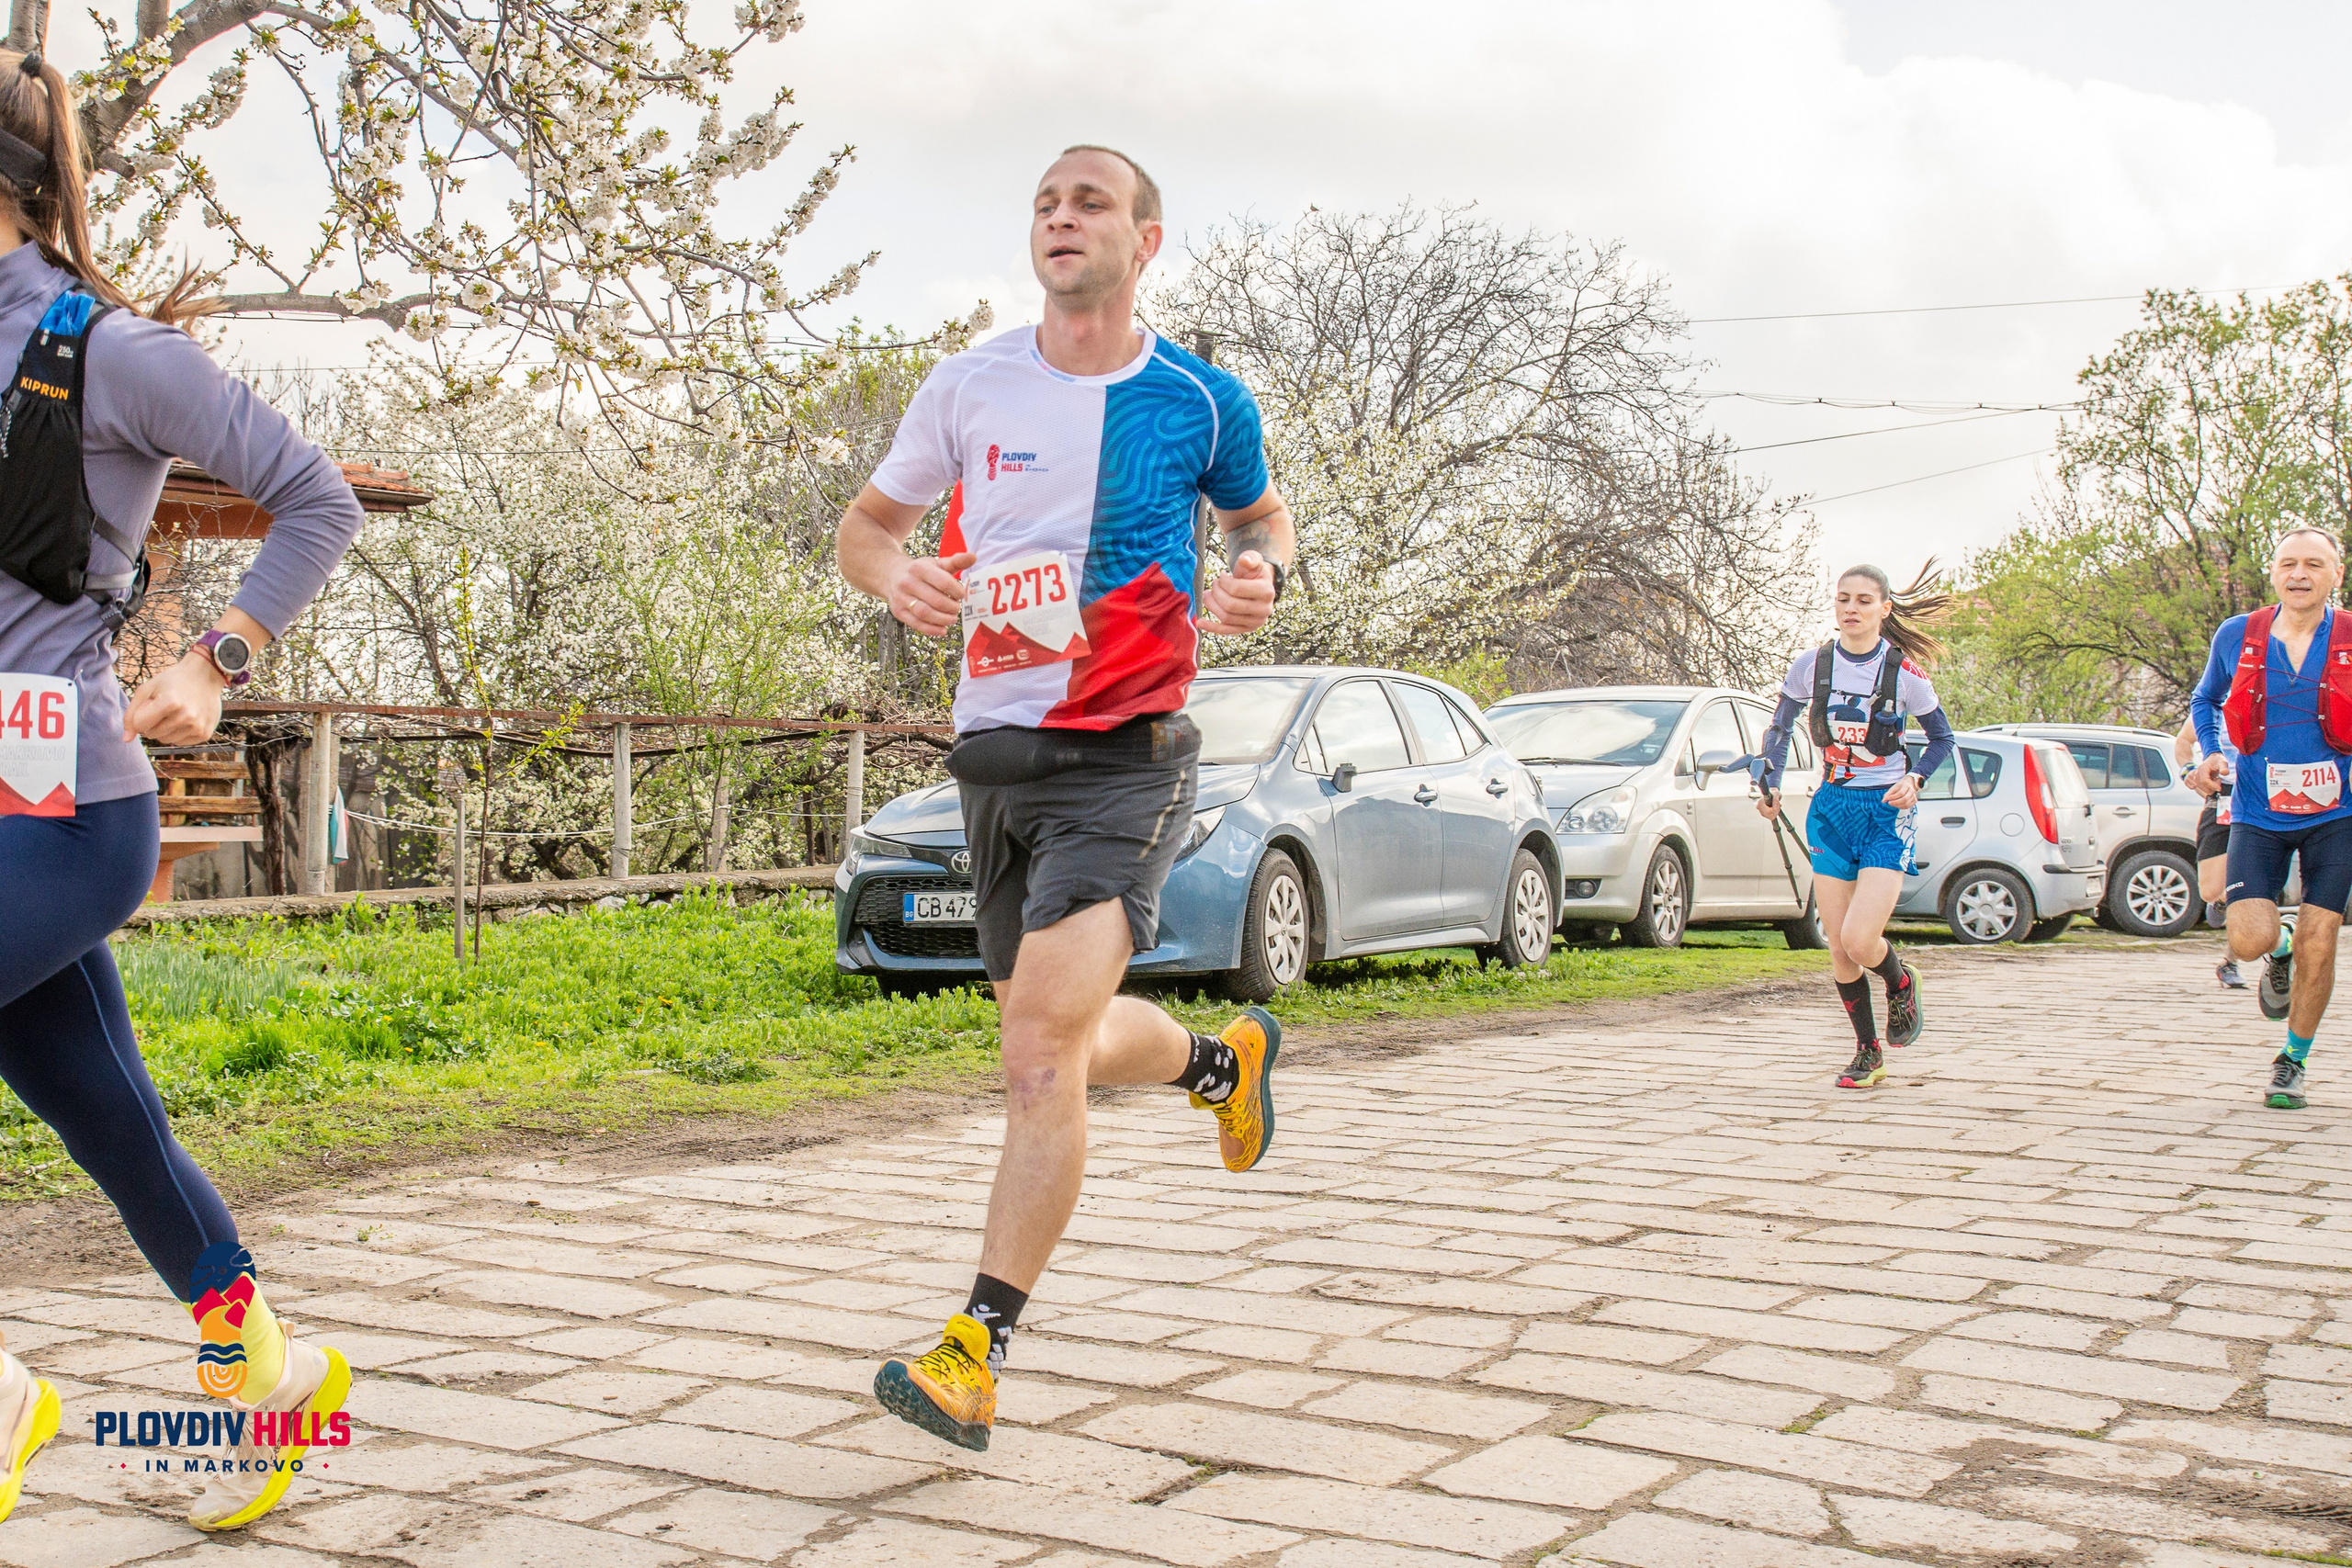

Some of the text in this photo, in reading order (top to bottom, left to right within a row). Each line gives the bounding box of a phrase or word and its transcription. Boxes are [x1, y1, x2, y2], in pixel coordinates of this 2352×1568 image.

[20, 377, 69, 400] KIPRUN
[1001, 453, 1036, 461] PLOVDIV
[1001, 463, 1023, 472] HILLS
[988, 563, 1066, 615] 2273
[0, 690, 65, 739] 46
[0, 761, 29, 777] RAIL
[2301, 766, 2336, 787] 2114
[917, 897, 942, 918] CB
